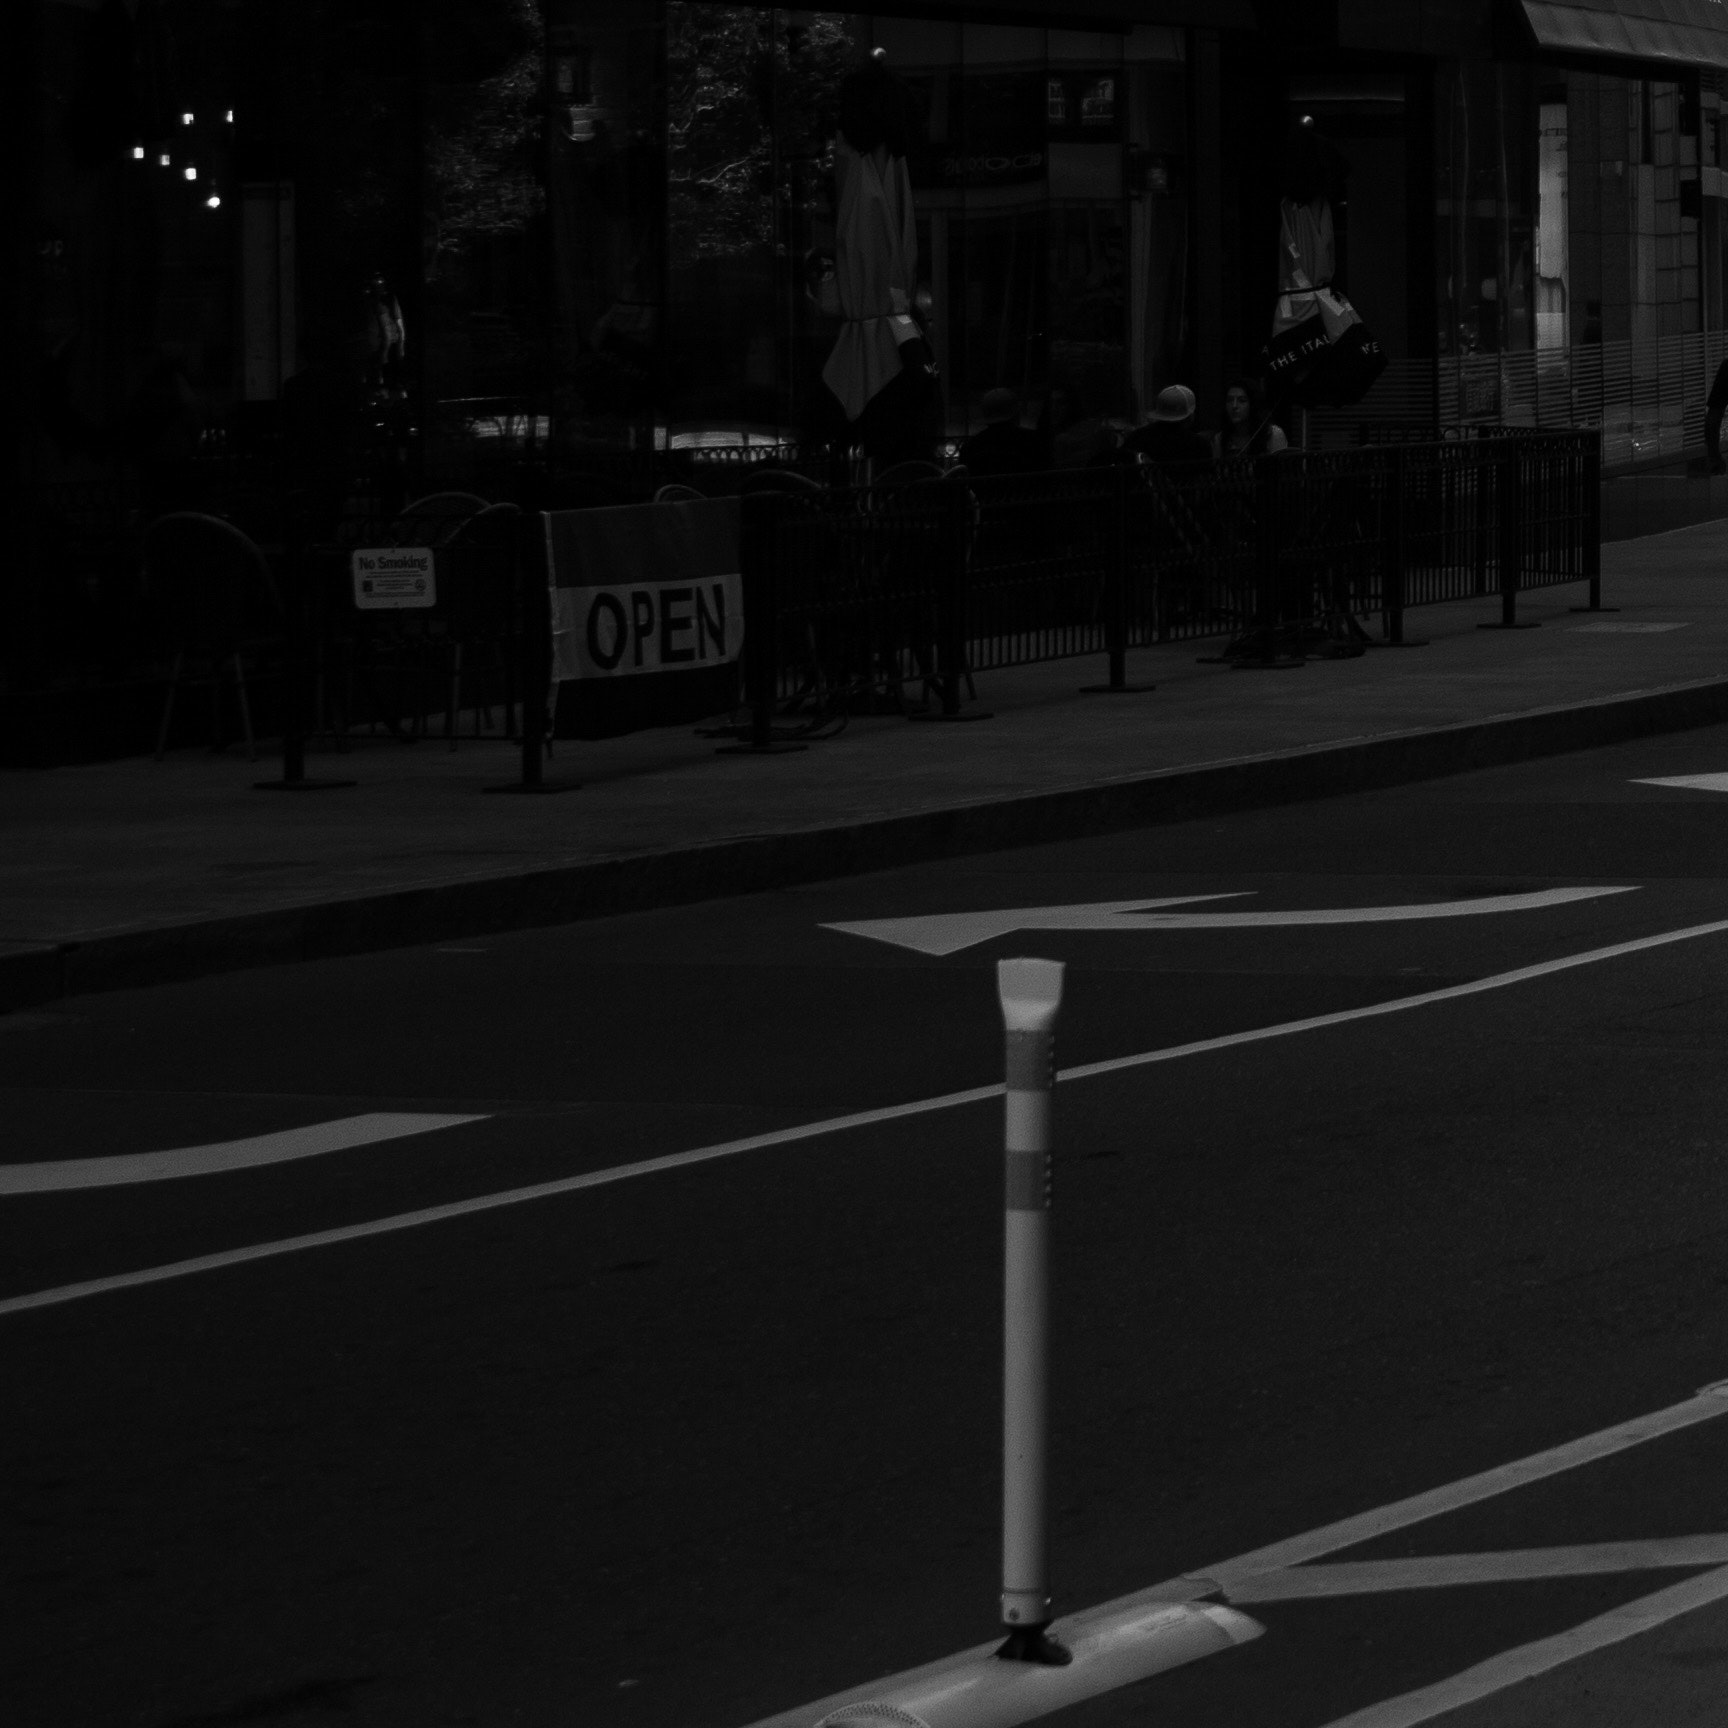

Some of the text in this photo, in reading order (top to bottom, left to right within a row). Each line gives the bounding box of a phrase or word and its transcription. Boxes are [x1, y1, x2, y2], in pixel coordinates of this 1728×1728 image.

[358, 555, 428, 571] No Smoking
[587, 583, 727, 671] OPEN
